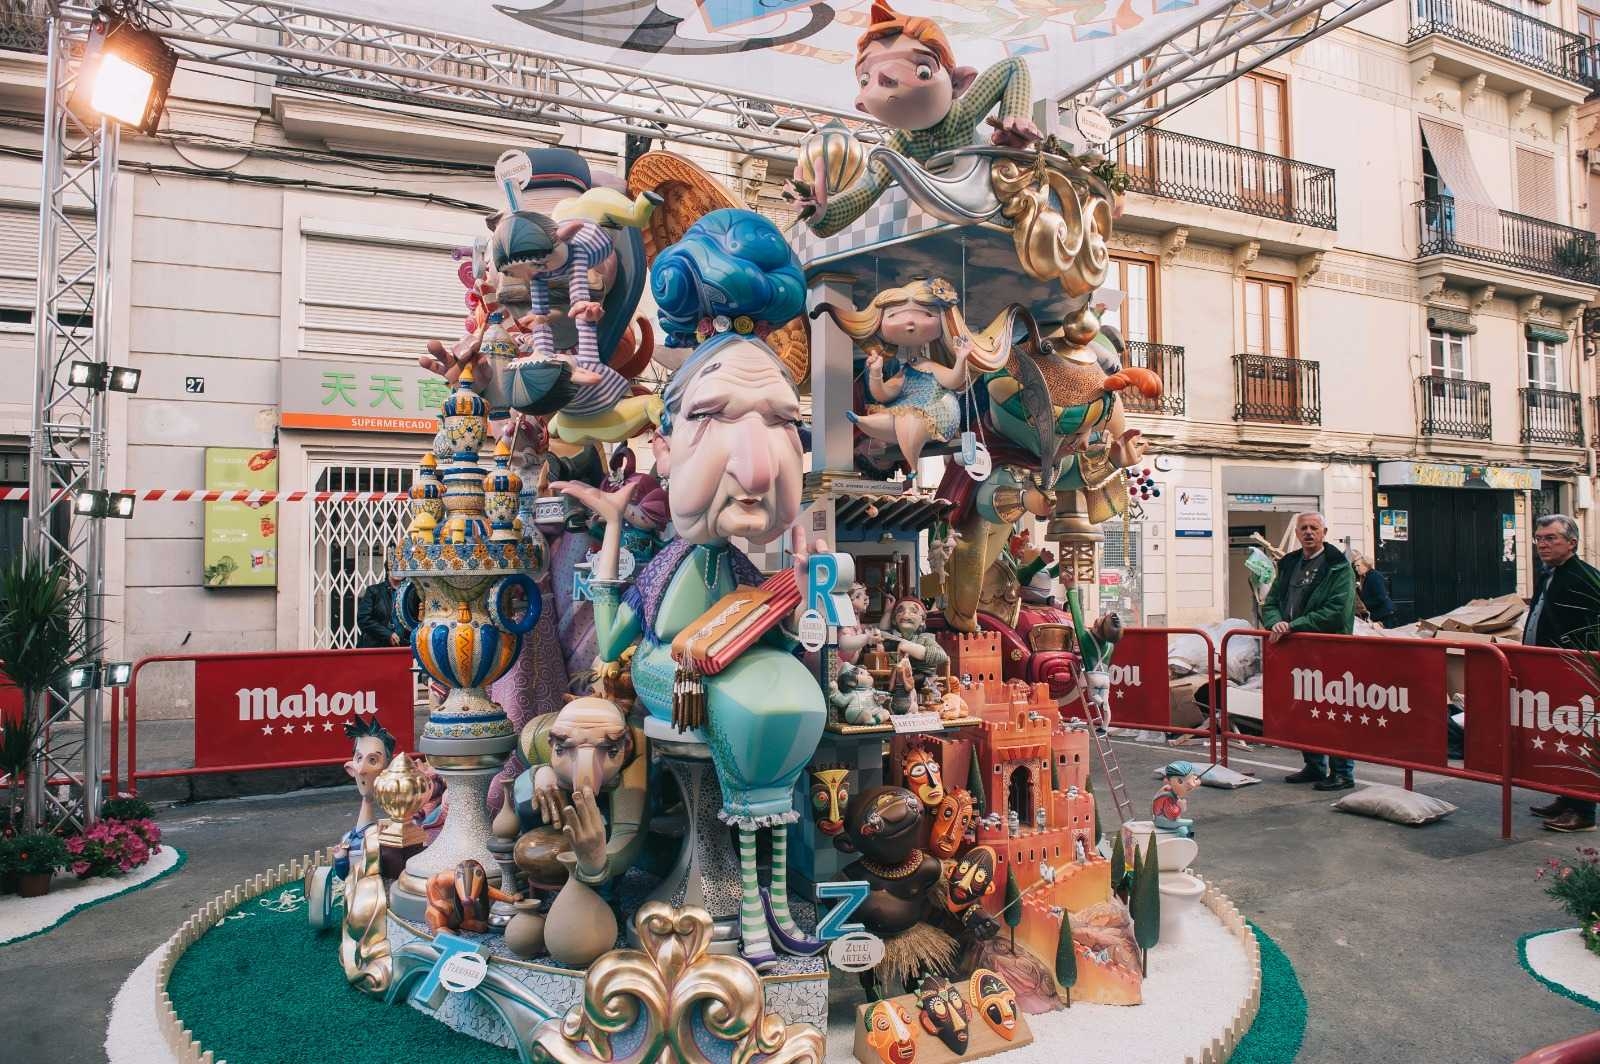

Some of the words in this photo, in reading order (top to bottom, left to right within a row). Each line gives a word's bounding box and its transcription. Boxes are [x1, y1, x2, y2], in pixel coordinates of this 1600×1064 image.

[187, 378, 204, 392] 27
[351, 417, 432, 430] SUPERMERCADO
[808, 554, 838, 625] R
[234, 683, 378, 721] Mahou
[1291, 667, 1412, 714] Mahou
[815, 881, 870, 940] Z
[414, 932, 480, 1003] T
